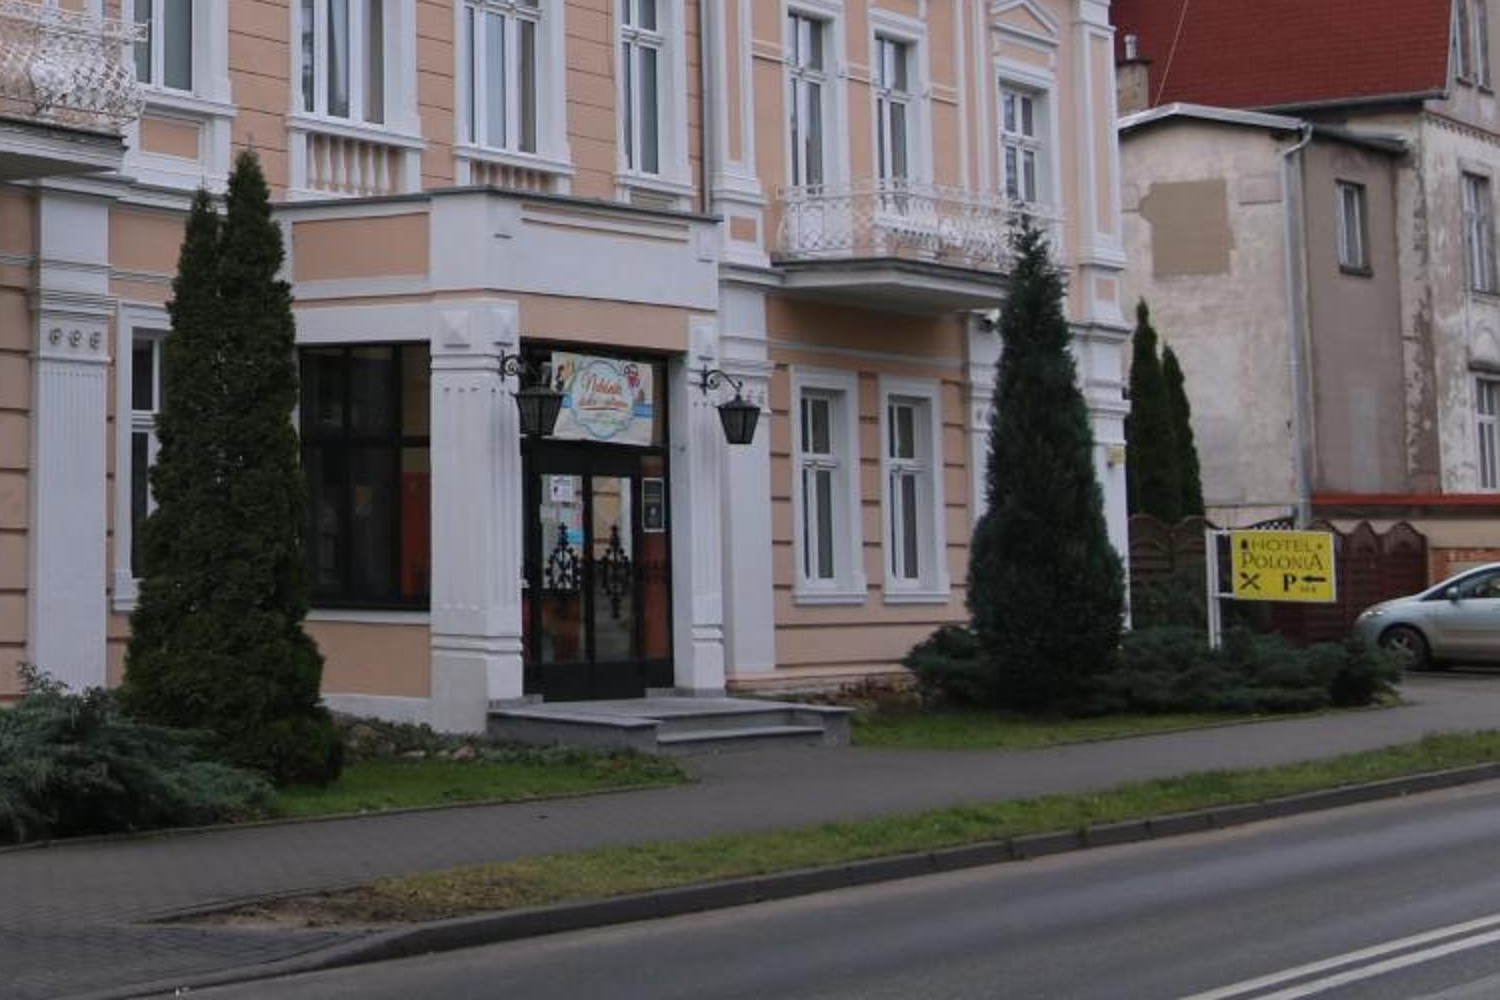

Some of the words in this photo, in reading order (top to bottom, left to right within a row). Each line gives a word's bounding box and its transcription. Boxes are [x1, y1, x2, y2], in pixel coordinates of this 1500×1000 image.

[1251, 538, 1313, 553] HOTEL
[1241, 551, 1324, 571] POLONIA
[1283, 573, 1297, 592] P
